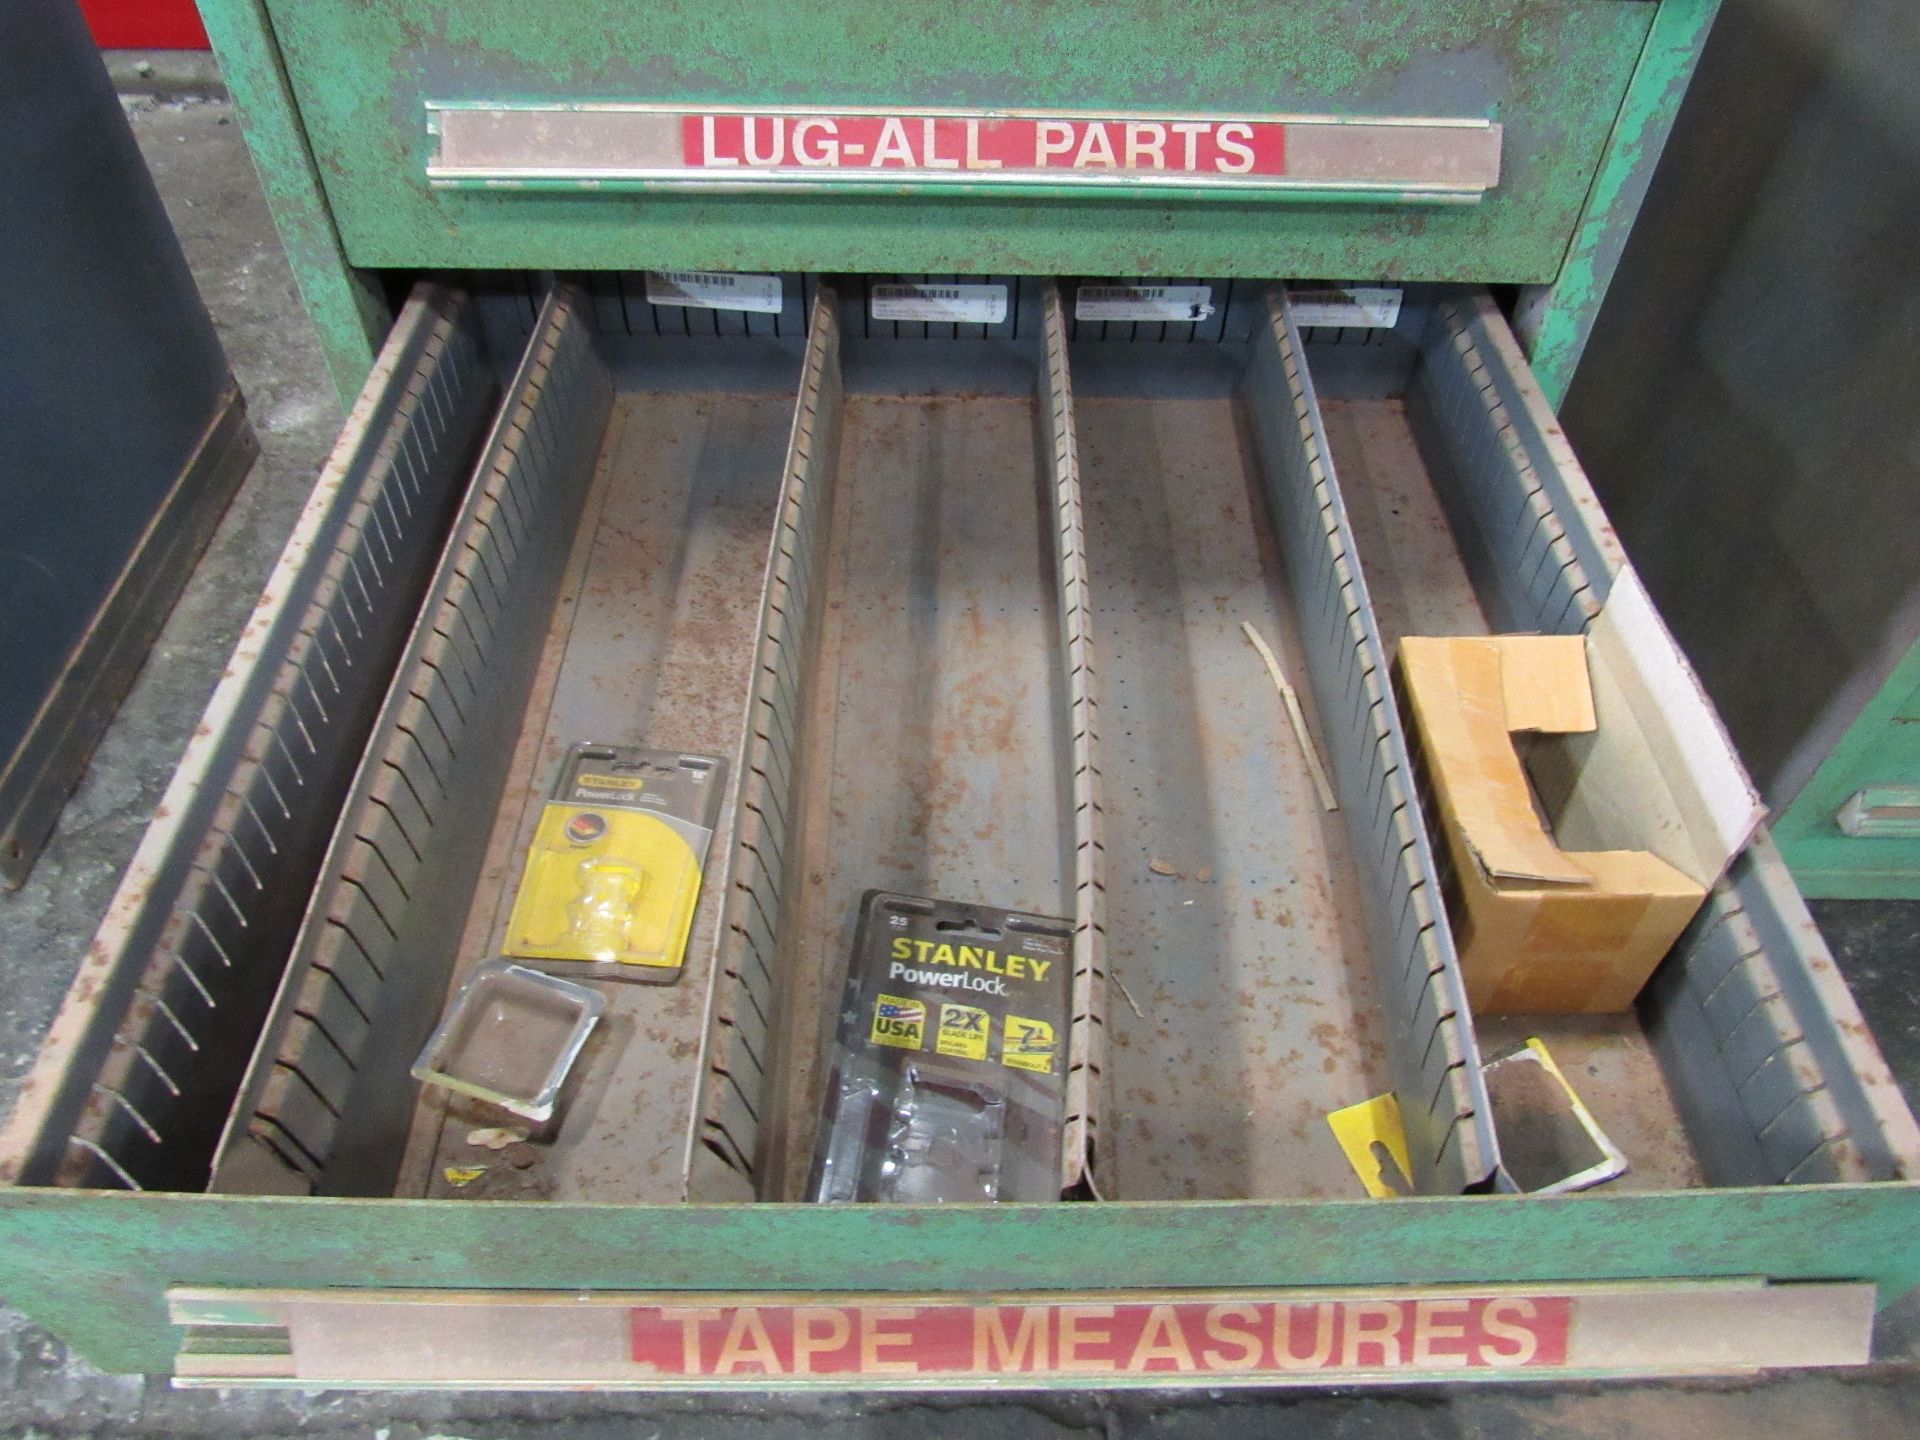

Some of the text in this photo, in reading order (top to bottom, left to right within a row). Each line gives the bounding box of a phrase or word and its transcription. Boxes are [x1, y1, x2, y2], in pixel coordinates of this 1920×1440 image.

[703, 116, 1255, 174] LUG-ALL PARTS
[889, 962, 1007, 996] PowerLock
[891, 937, 1052, 982] STANLEY
[876, 1018, 919, 1039] USA
[944, 1008, 985, 1032] 2X
[659, 1297, 1539, 1375] TAPE MEASURES
